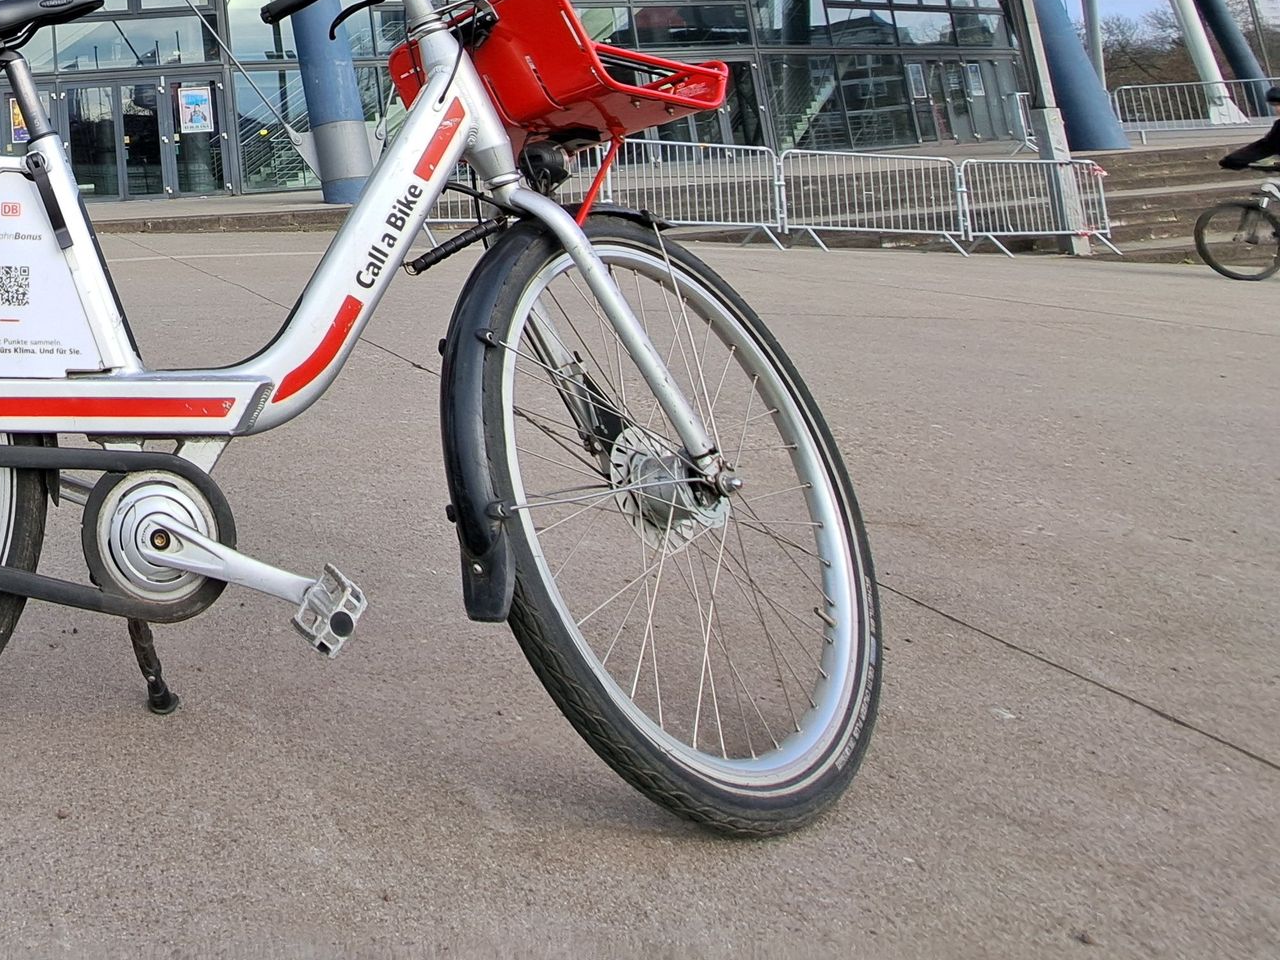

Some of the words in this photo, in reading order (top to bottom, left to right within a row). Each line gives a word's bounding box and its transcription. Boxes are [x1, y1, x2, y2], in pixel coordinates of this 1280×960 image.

[3, 204, 19, 215] DB
[385, 184, 424, 232] Bike
[381, 232, 398, 249] a
[356, 245, 389, 289] Call
